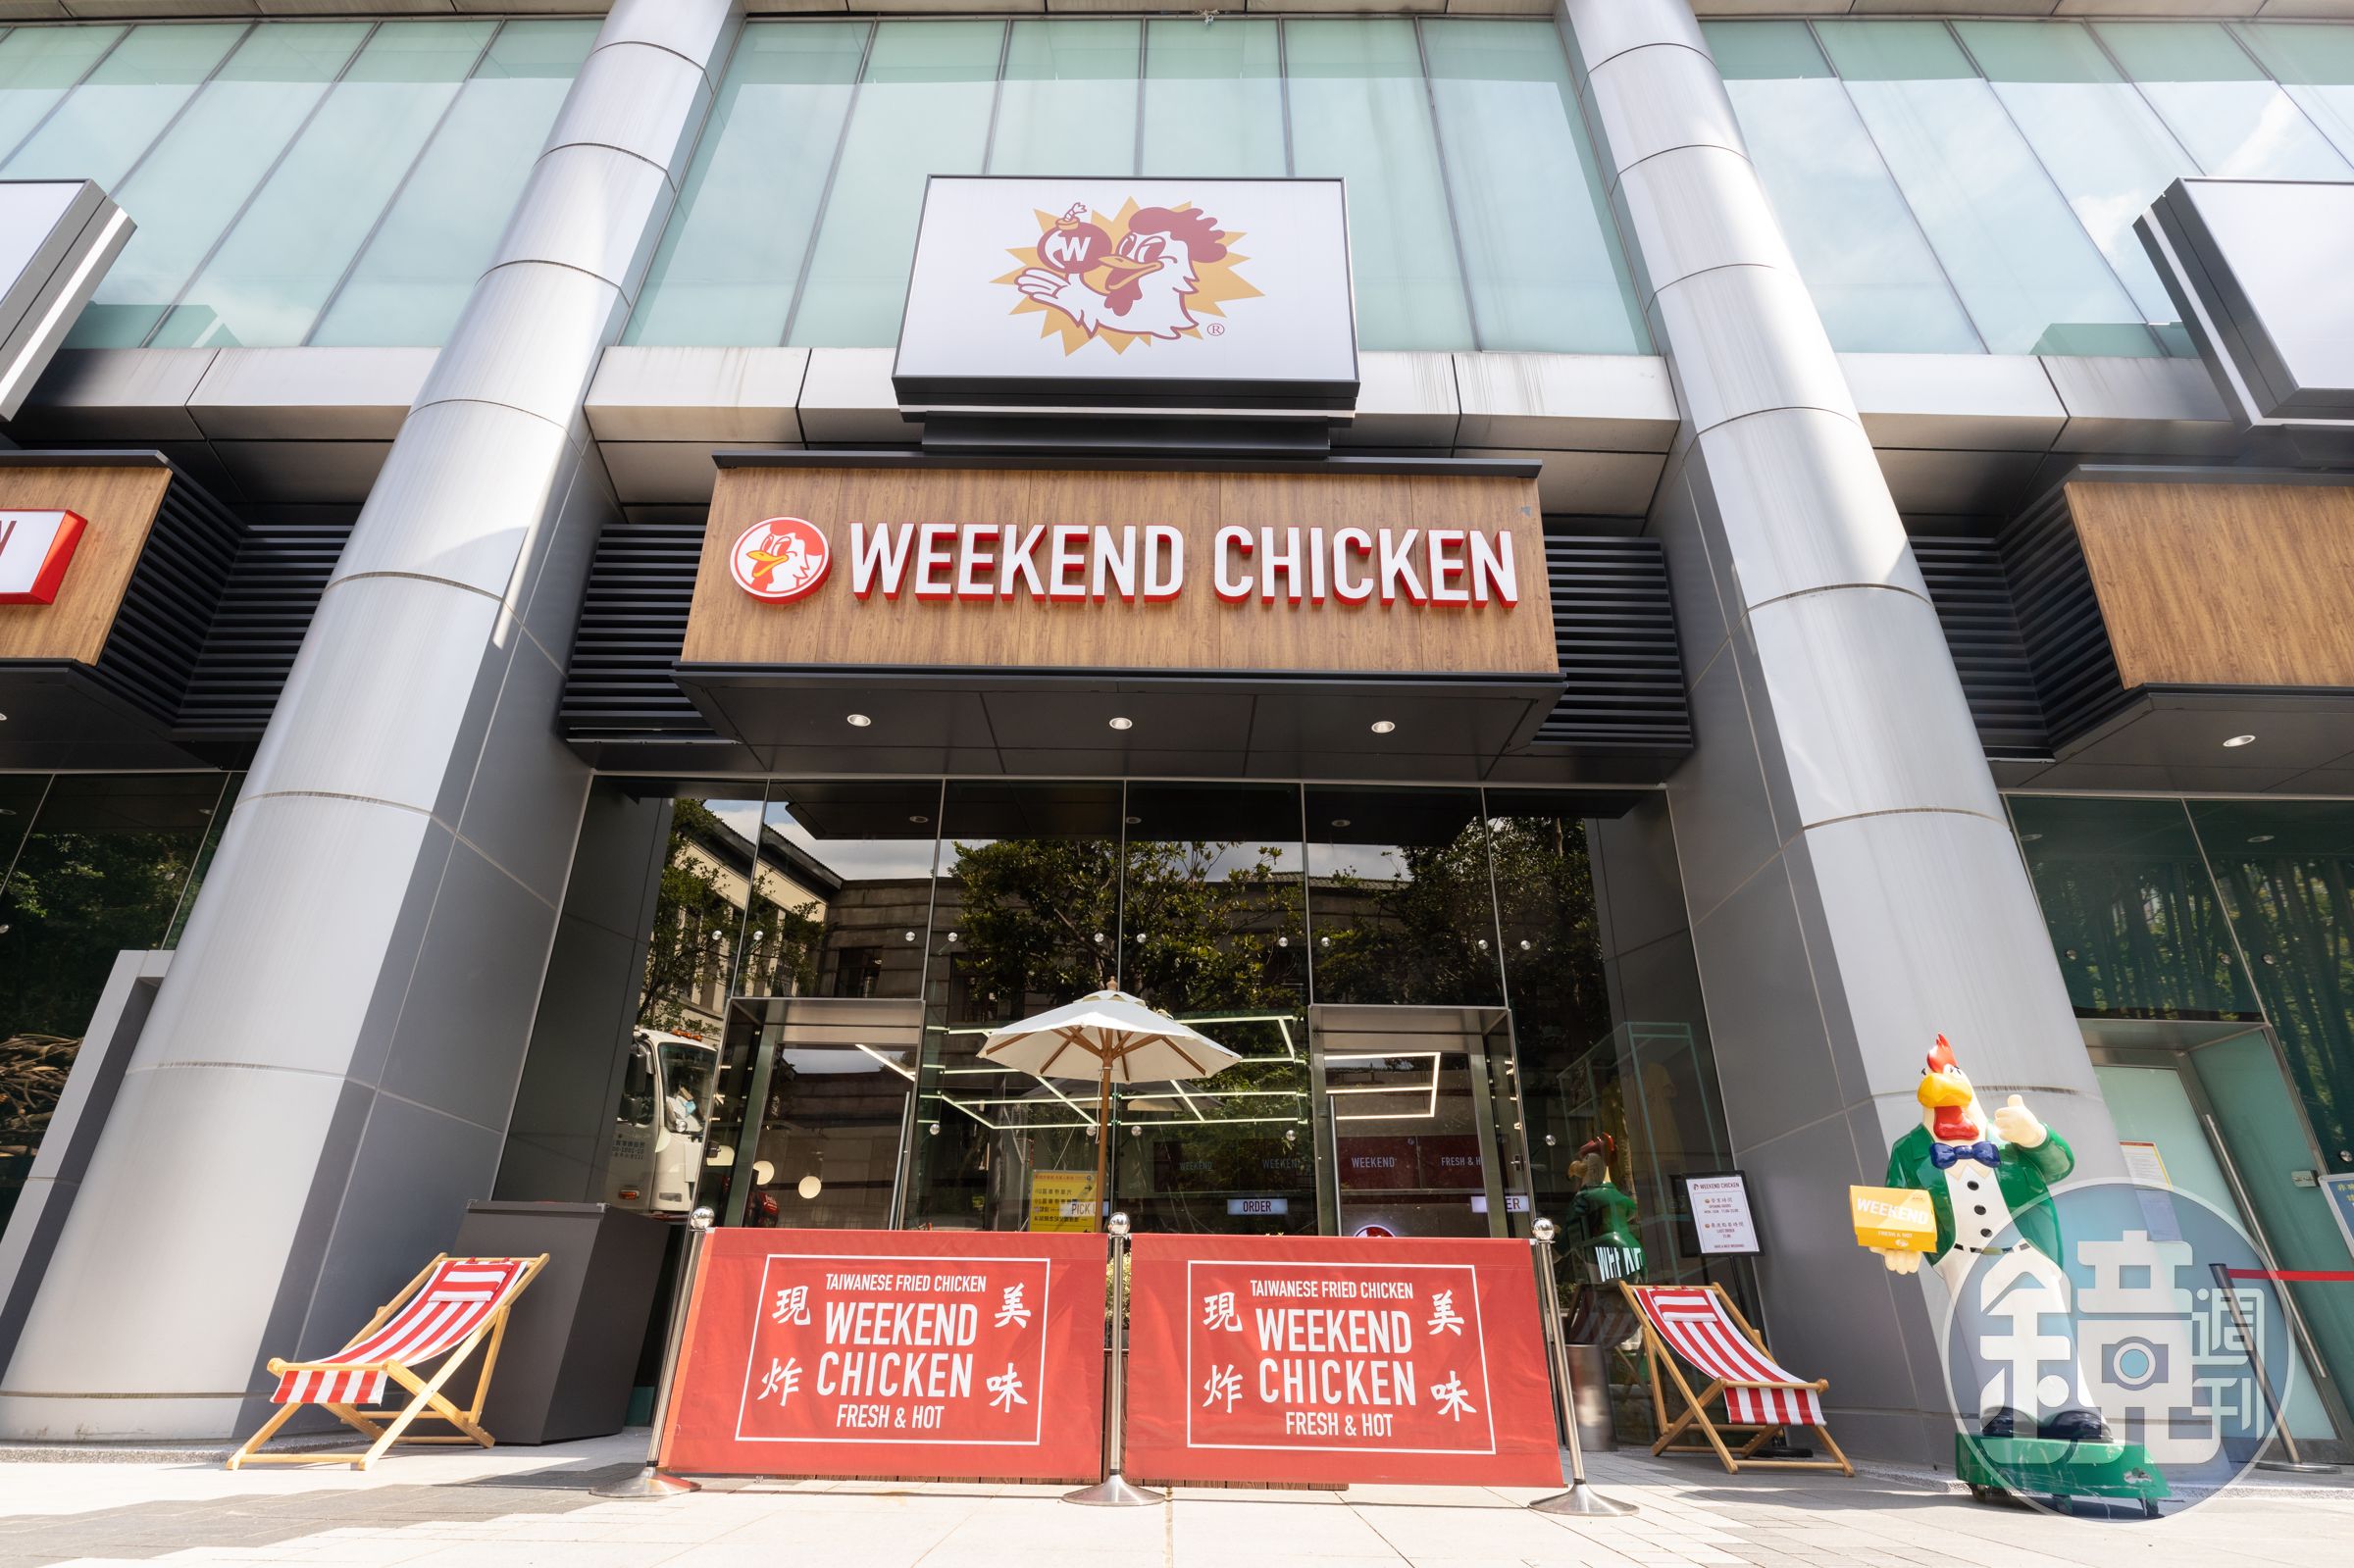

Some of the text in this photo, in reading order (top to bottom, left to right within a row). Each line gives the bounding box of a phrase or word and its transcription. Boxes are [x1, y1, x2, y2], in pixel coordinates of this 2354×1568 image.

[1061, 236, 1092, 262] W
[850, 522, 1518, 608] WEEKEND CHICKEN
[1352, 1157, 1395, 1168] WEEKEND
[1441, 1156, 1465, 1166] FRESH
[1071, 1203, 1090, 1215] PICK
[1243, 1200, 1272, 1213] ORDER
[1857, 1197, 1929, 1225] WEEKEND
[826, 1273, 987, 1292] TAIWANESE FRIED CHICKEN
[1251, 1280, 1413, 1299] TAIWANESE FRIED CHICKEN
[825, 1301, 978, 1346] WEEKEND
[1254, 1308, 1412, 1354] WEEKEND
[816, 1351, 973, 1397] CHICKEN
[1258, 1358, 1416, 1406] CHICKEN
[836, 1404, 945, 1429] FRESH & HOT
[1285, 1411, 1393, 1438] FRESH & HOT
